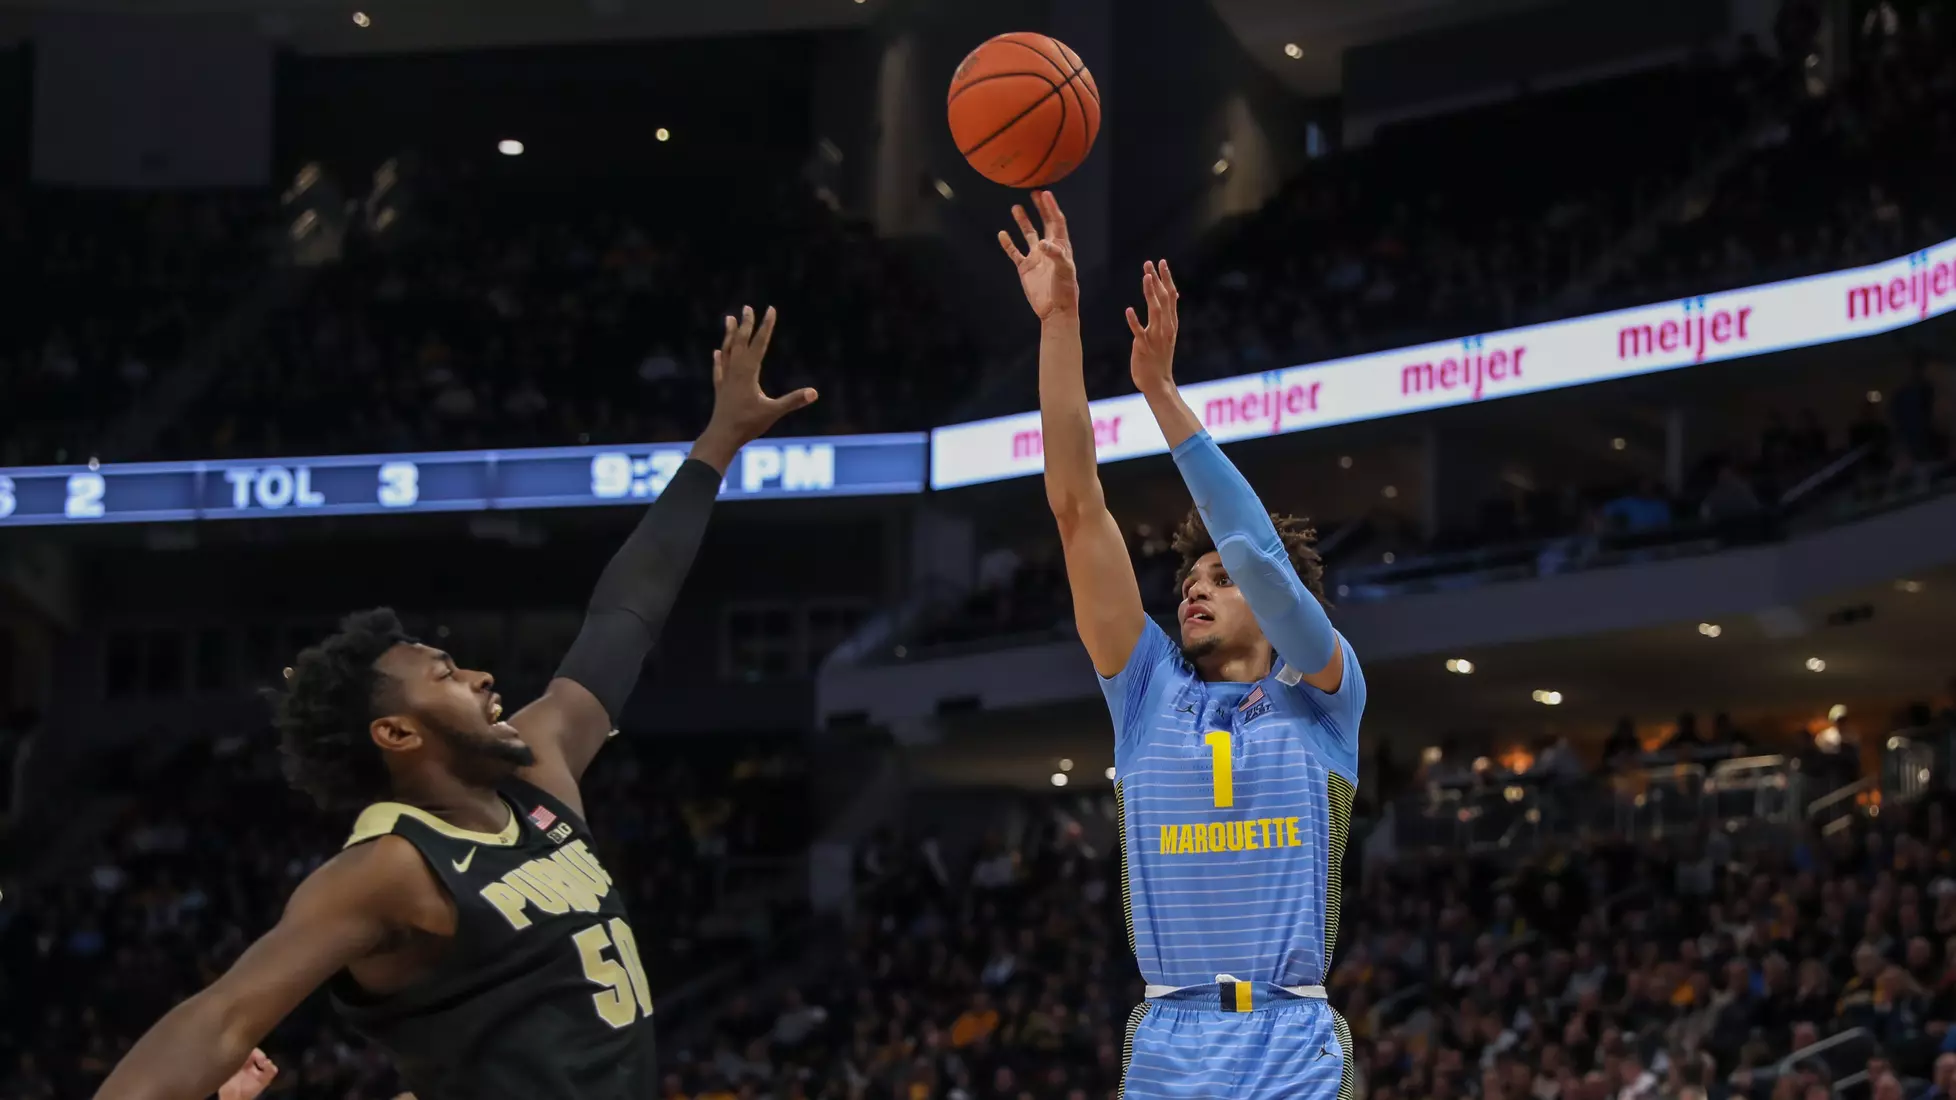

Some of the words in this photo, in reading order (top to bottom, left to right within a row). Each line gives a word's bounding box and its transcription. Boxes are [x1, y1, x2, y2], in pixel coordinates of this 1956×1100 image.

[1848, 250, 1956, 320] meije
[1618, 296, 1753, 364] meijer
[1402, 336, 1527, 400] meijer
[1205, 371, 1322, 434] meijer
[65, 473, 105, 518] 2
[226, 465, 325, 509] TOL
[378, 461, 419, 507] 3
[741, 444, 836, 492] PM
[1205, 731, 1233, 808] 1
[1160, 817, 1301, 855] MARQUETTE
[572, 916, 653, 1028] 50
